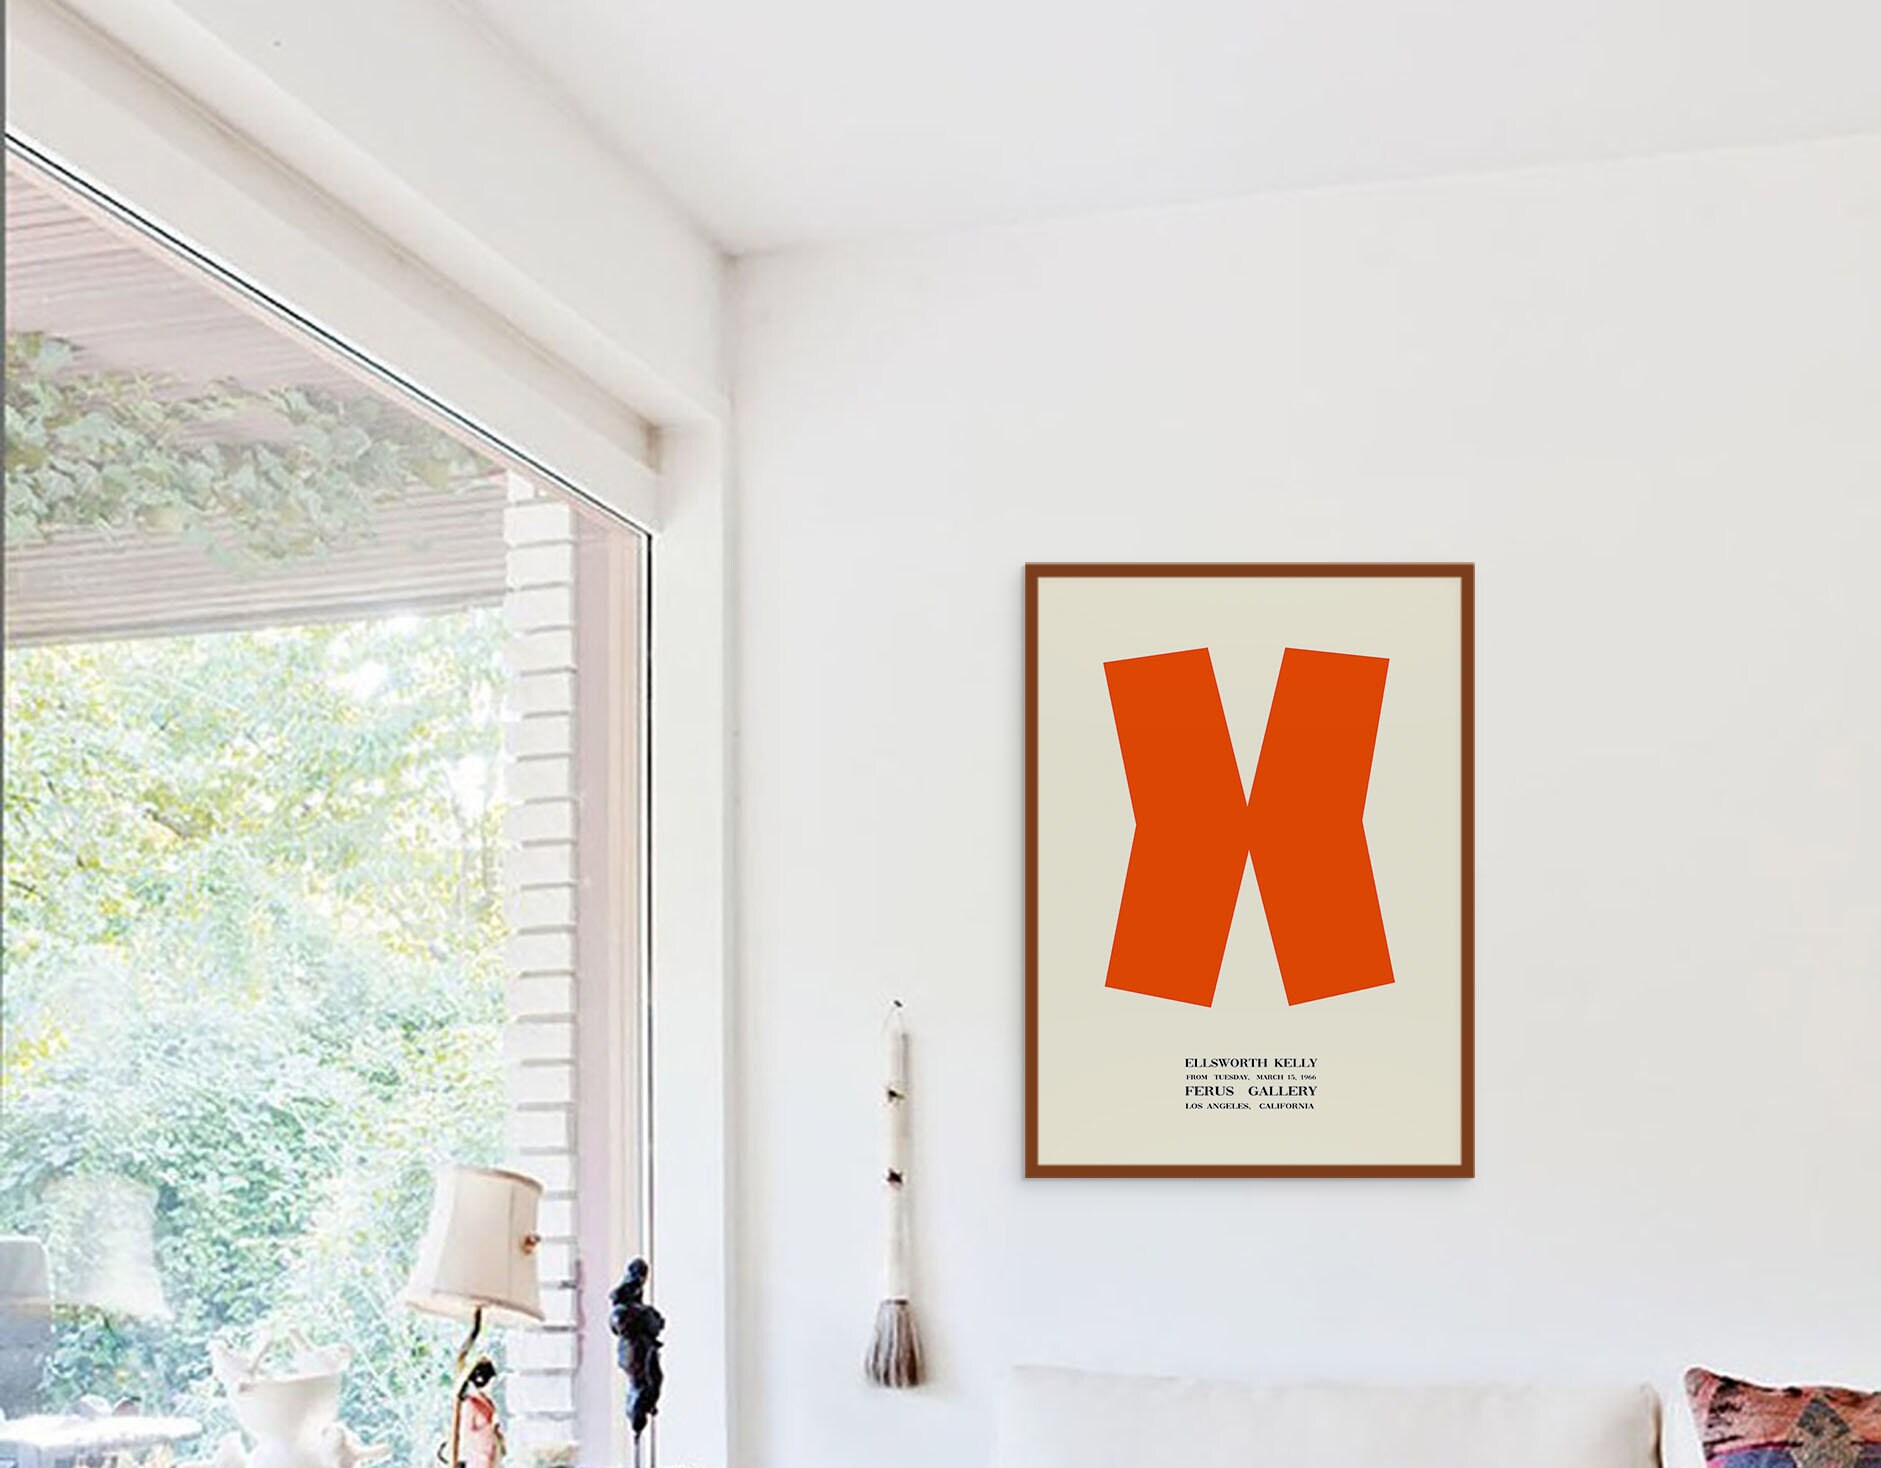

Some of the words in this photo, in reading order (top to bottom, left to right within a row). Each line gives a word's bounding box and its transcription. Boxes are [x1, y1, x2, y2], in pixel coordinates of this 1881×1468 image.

[1185, 1057, 1268, 1068] ELLSWORTH
[1274, 1057, 1318, 1068] KELLY
[1185, 1085, 1235, 1097] FERUS
[1247, 1085, 1318, 1097] GALLERY
[1185, 1102, 1204, 1110] LOS
[1258, 1102, 1315, 1110] CALIFORNIA
